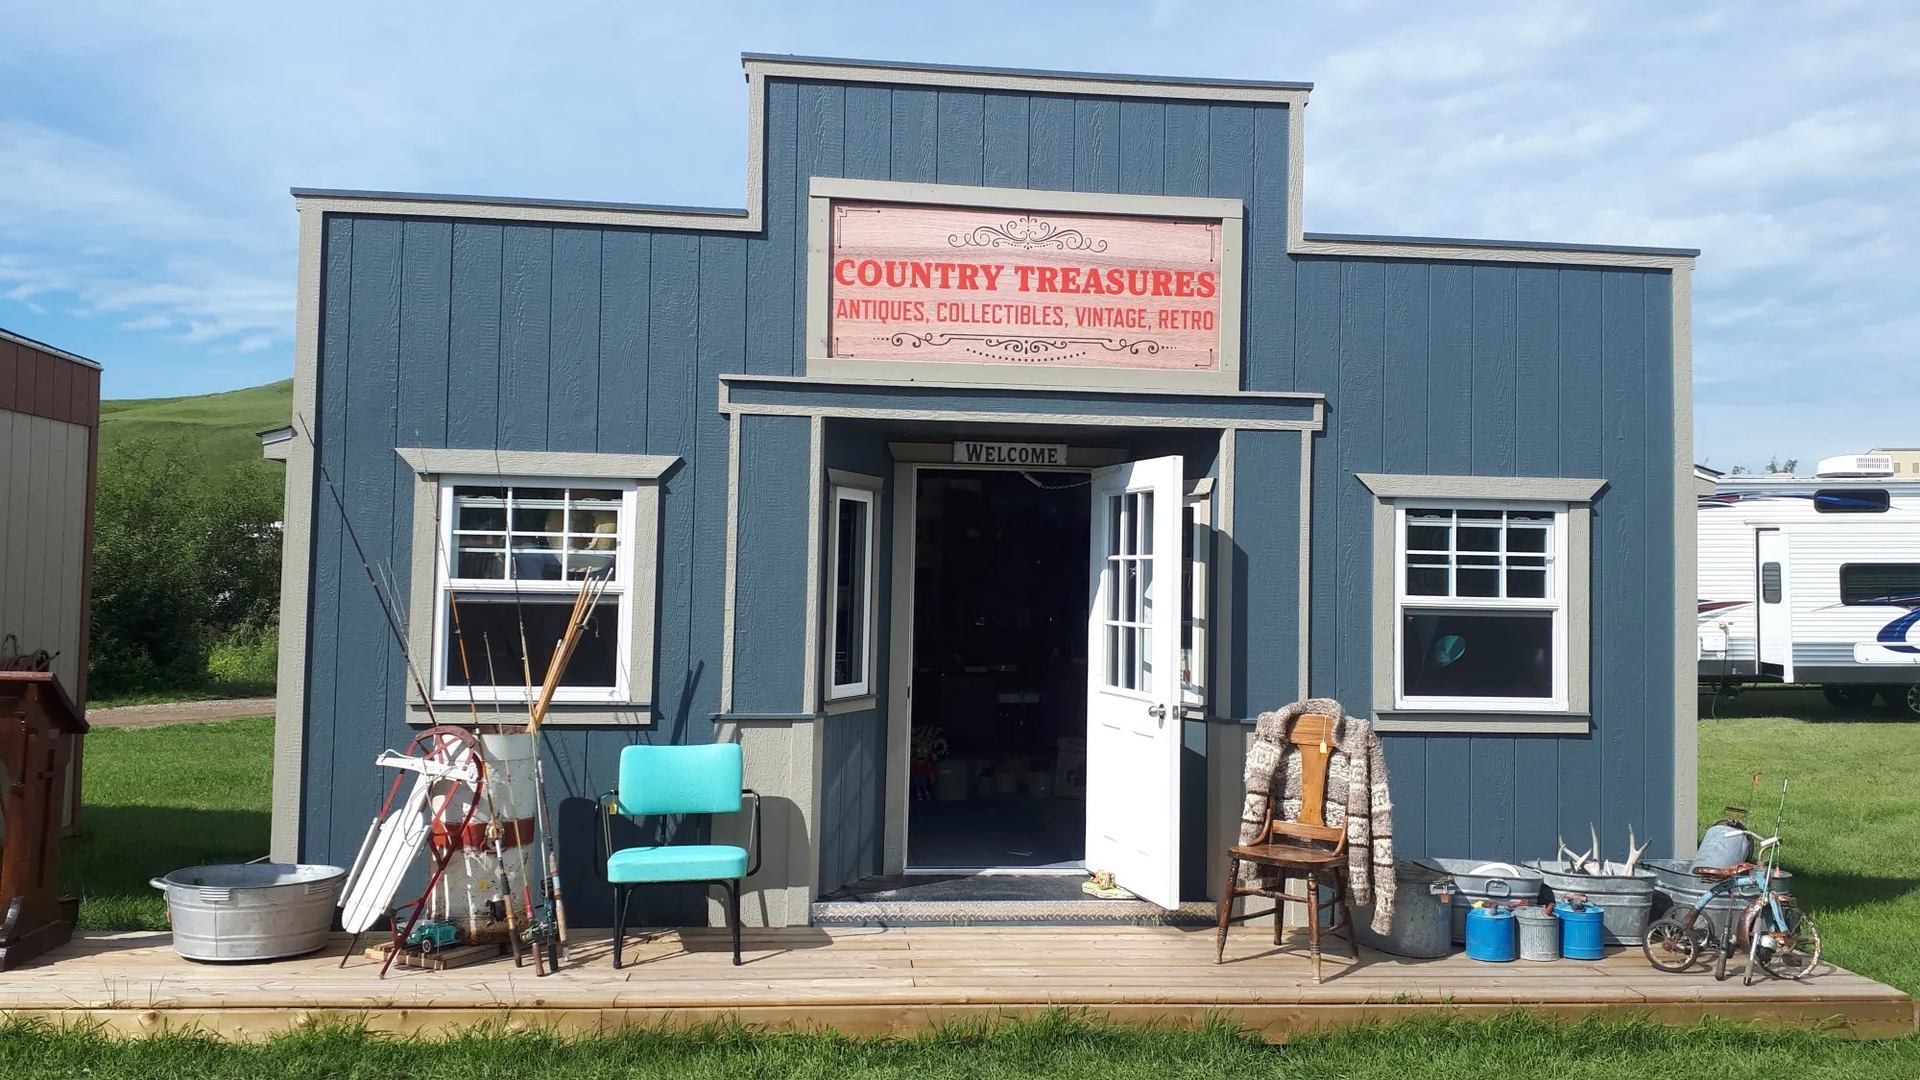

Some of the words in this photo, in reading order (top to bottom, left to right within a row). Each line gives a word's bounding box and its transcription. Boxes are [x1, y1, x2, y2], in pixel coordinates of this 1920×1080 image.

[834, 259, 1005, 292] COUNTRY
[1014, 265, 1216, 298] TREASURES
[836, 299, 930, 324] ANTIQUES,
[936, 302, 1069, 328] COLLECTIBLES,
[1075, 306, 1153, 331] VINTAGE,
[1158, 309, 1214, 331] RETRO
[965, 443, 1057, 464] WELCOME
